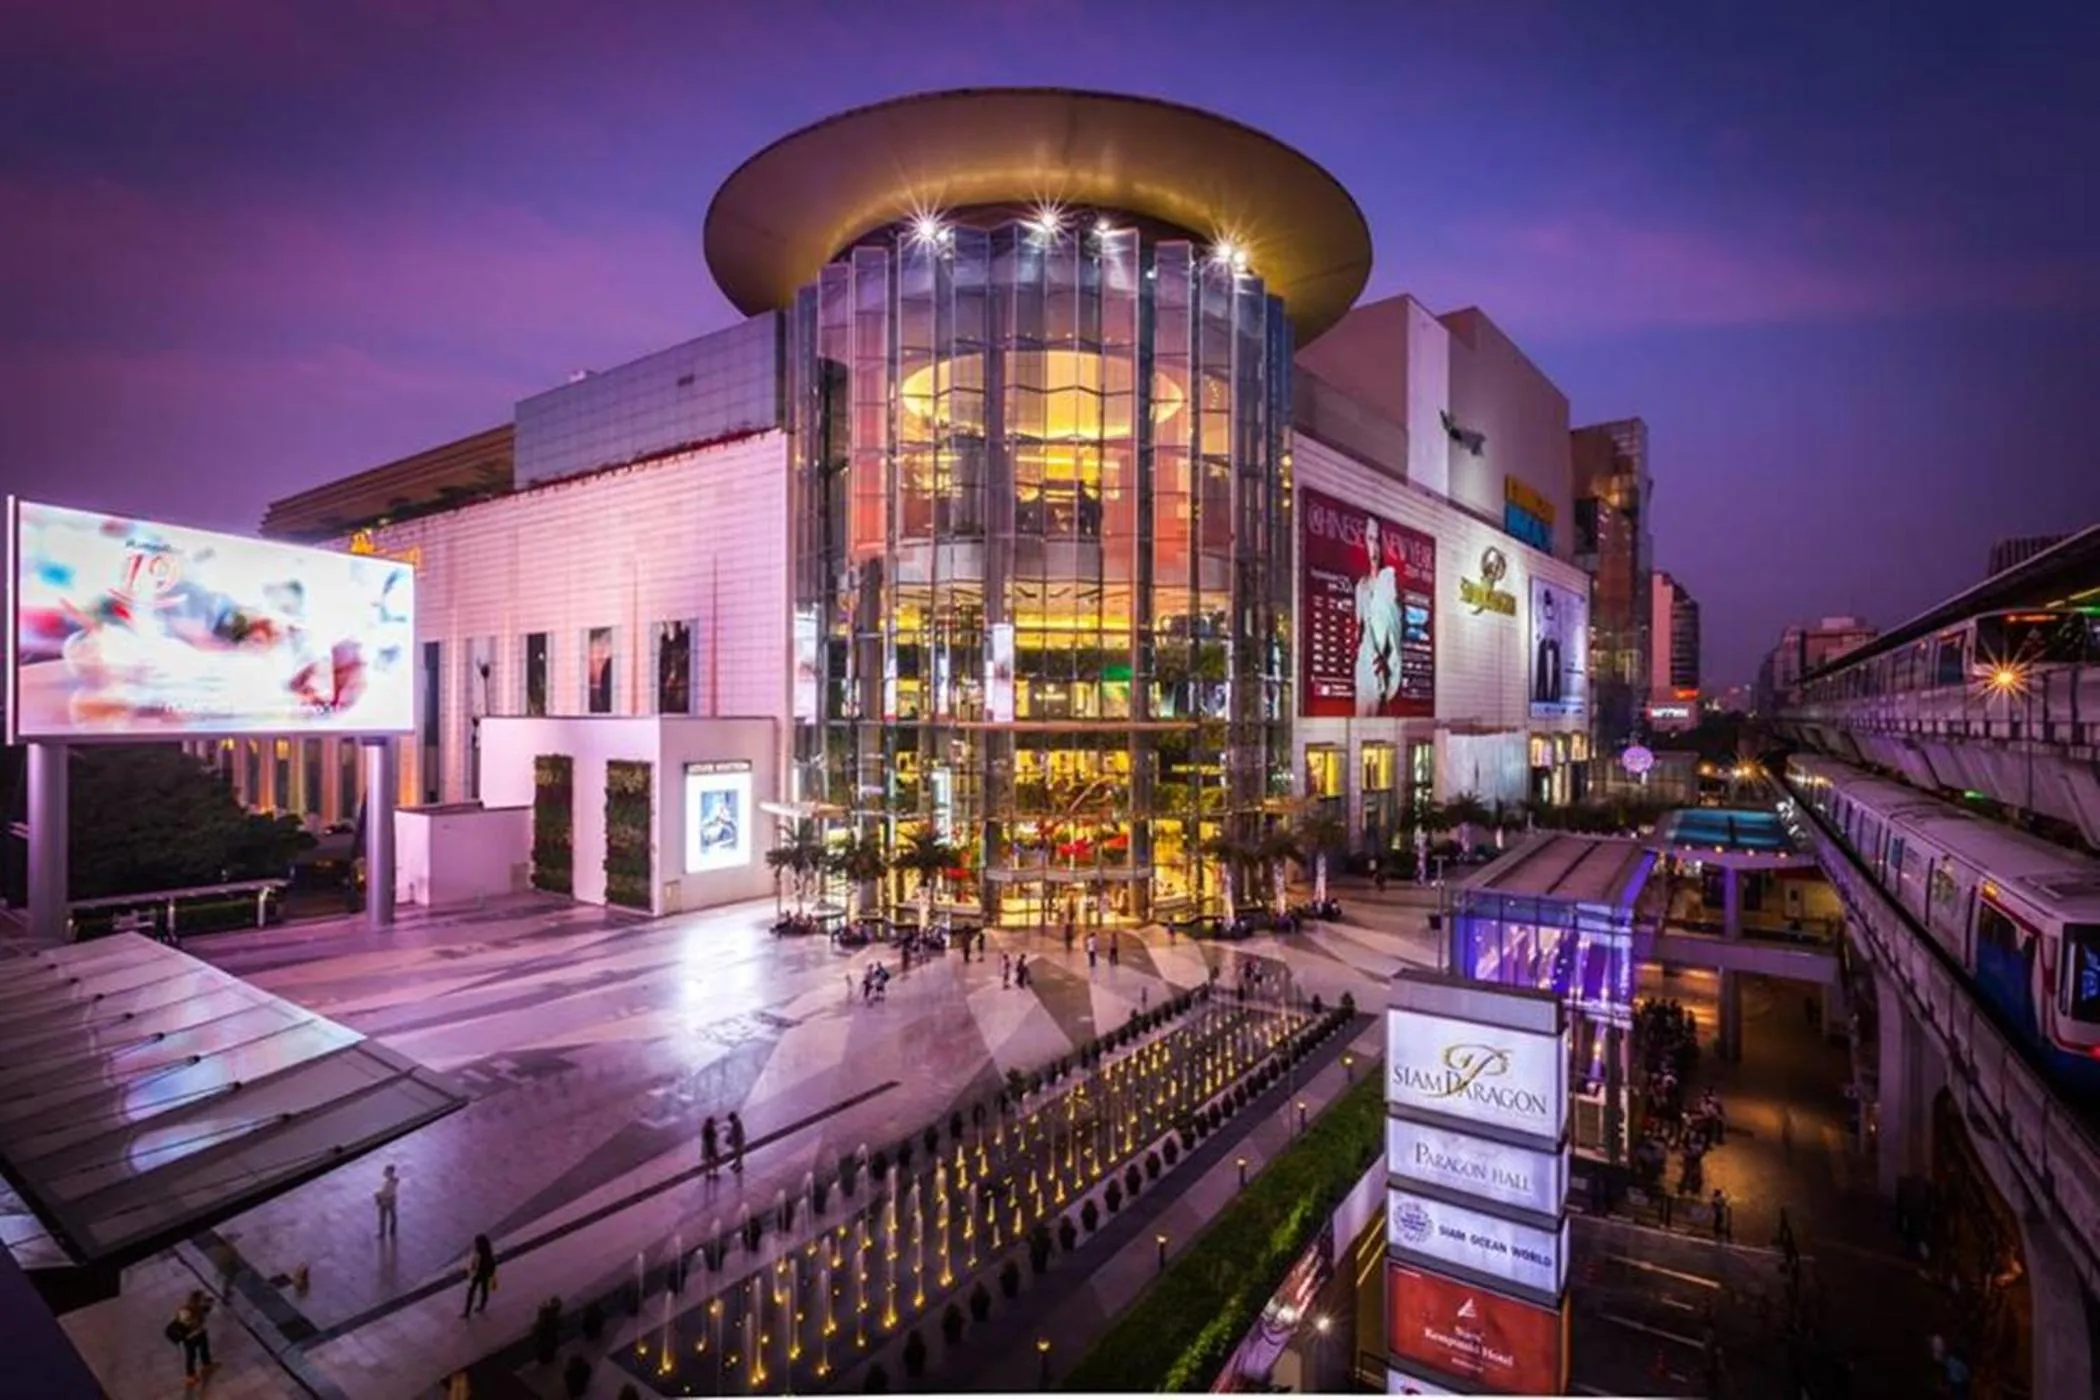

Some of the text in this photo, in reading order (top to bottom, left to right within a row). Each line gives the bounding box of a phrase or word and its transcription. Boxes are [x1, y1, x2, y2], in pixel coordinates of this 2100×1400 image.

[1392, 1064, 1547, 1115] SIAM PARAGON
[1492, 1169, 1530, 1191] HALL
[1438, 1225, 1553, 1269] SIAM OCEAN WORLD
